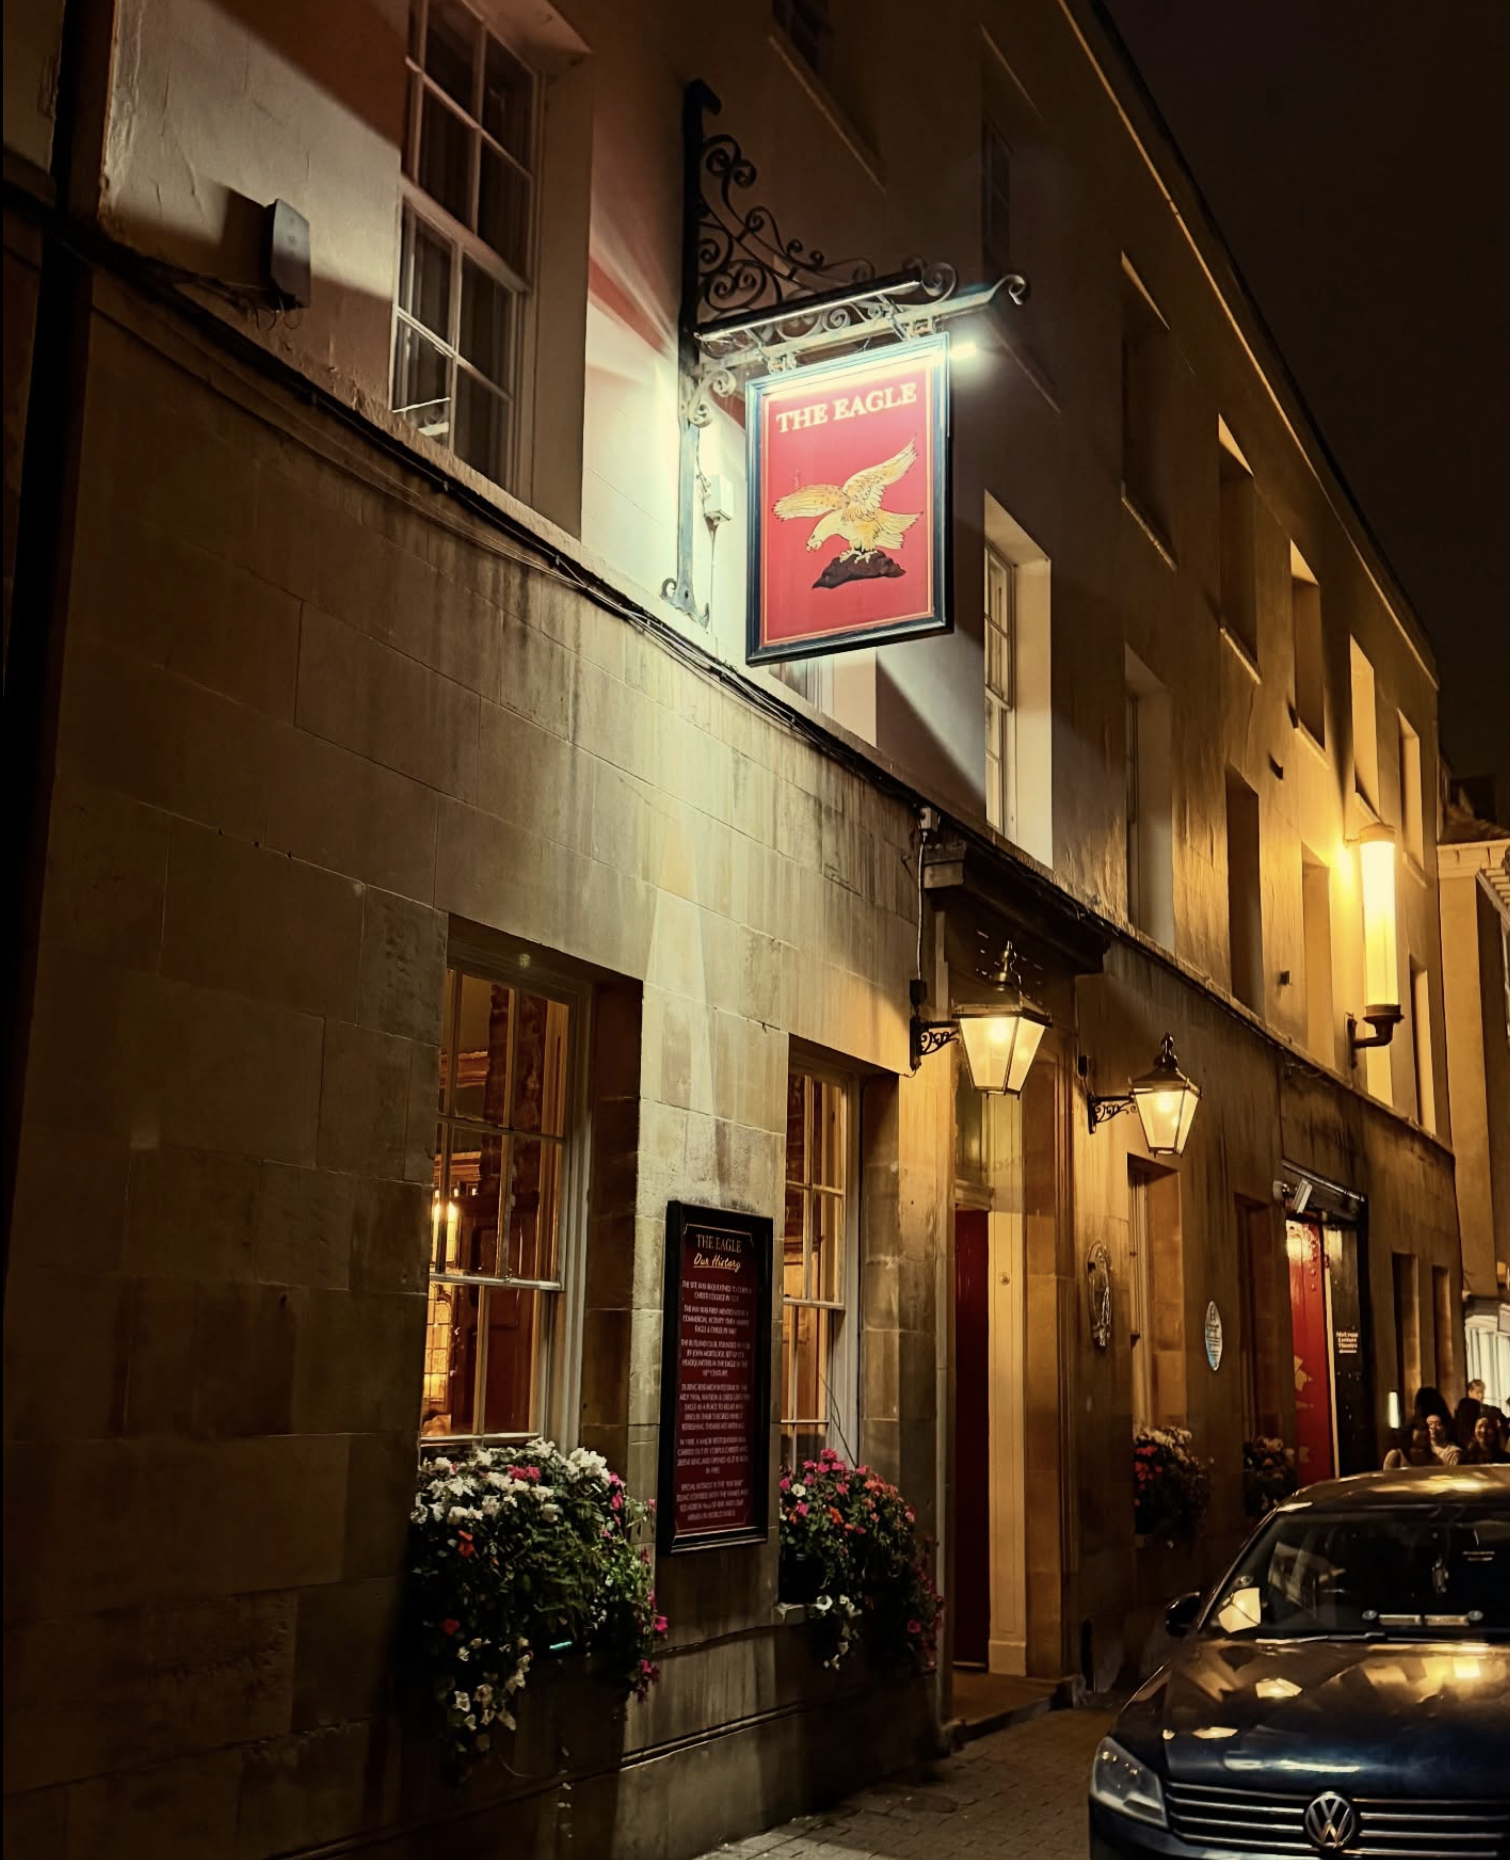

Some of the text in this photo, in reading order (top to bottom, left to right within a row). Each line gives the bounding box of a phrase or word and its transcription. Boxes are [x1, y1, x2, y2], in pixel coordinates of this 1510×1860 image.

[776, 383, 917, 433] THE EAGLE
[696, 1234, 742, 1253] THE EAGLE
[694, 1252, 741, 1273] Our History
